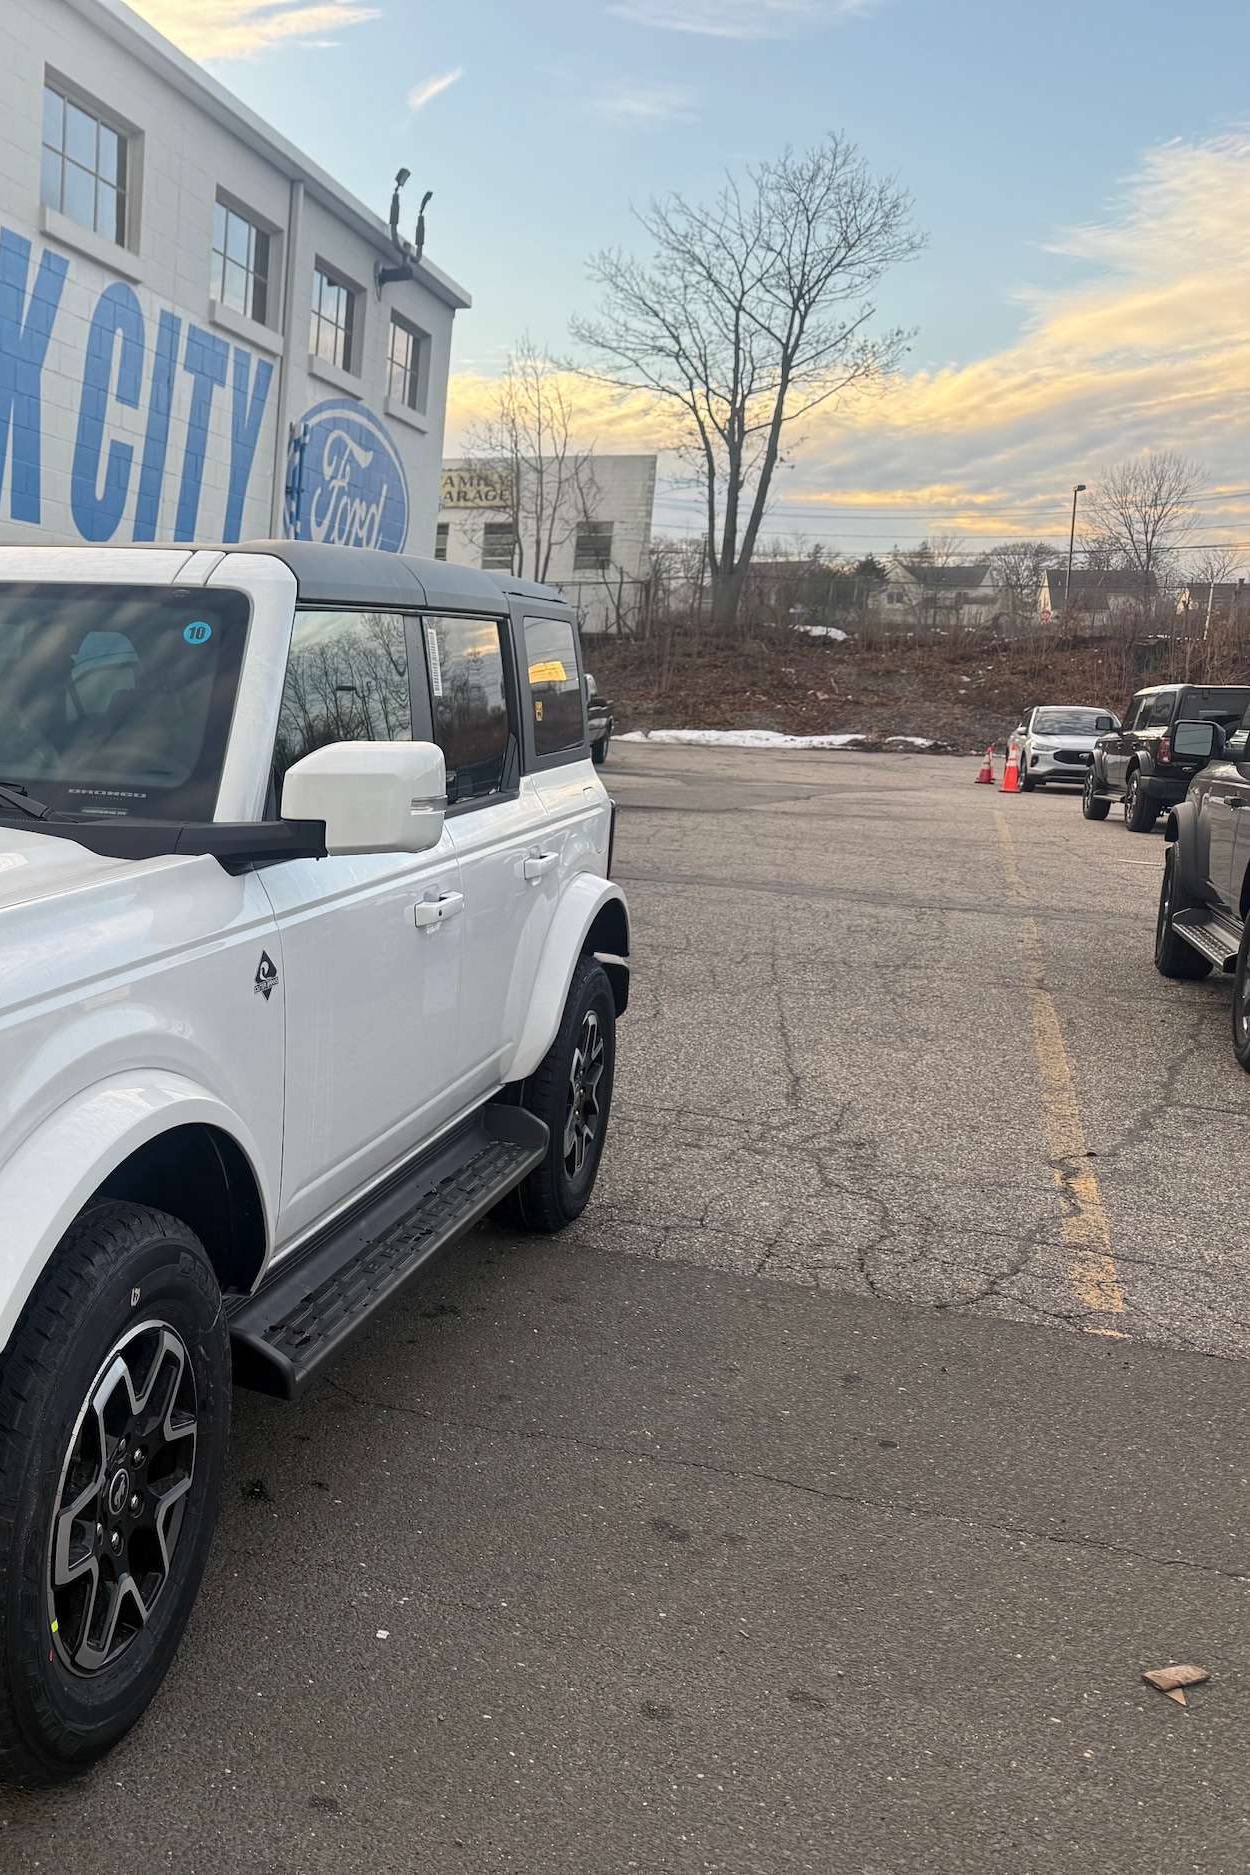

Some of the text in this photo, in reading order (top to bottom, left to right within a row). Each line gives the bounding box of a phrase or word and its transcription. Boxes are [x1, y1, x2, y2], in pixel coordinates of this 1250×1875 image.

[70, 282, 274, 543] CITY
[310, 429, 388, 550] Ford
[443, 490, 510, 502] ARAGE
[189, 626, 207, 640] 10
